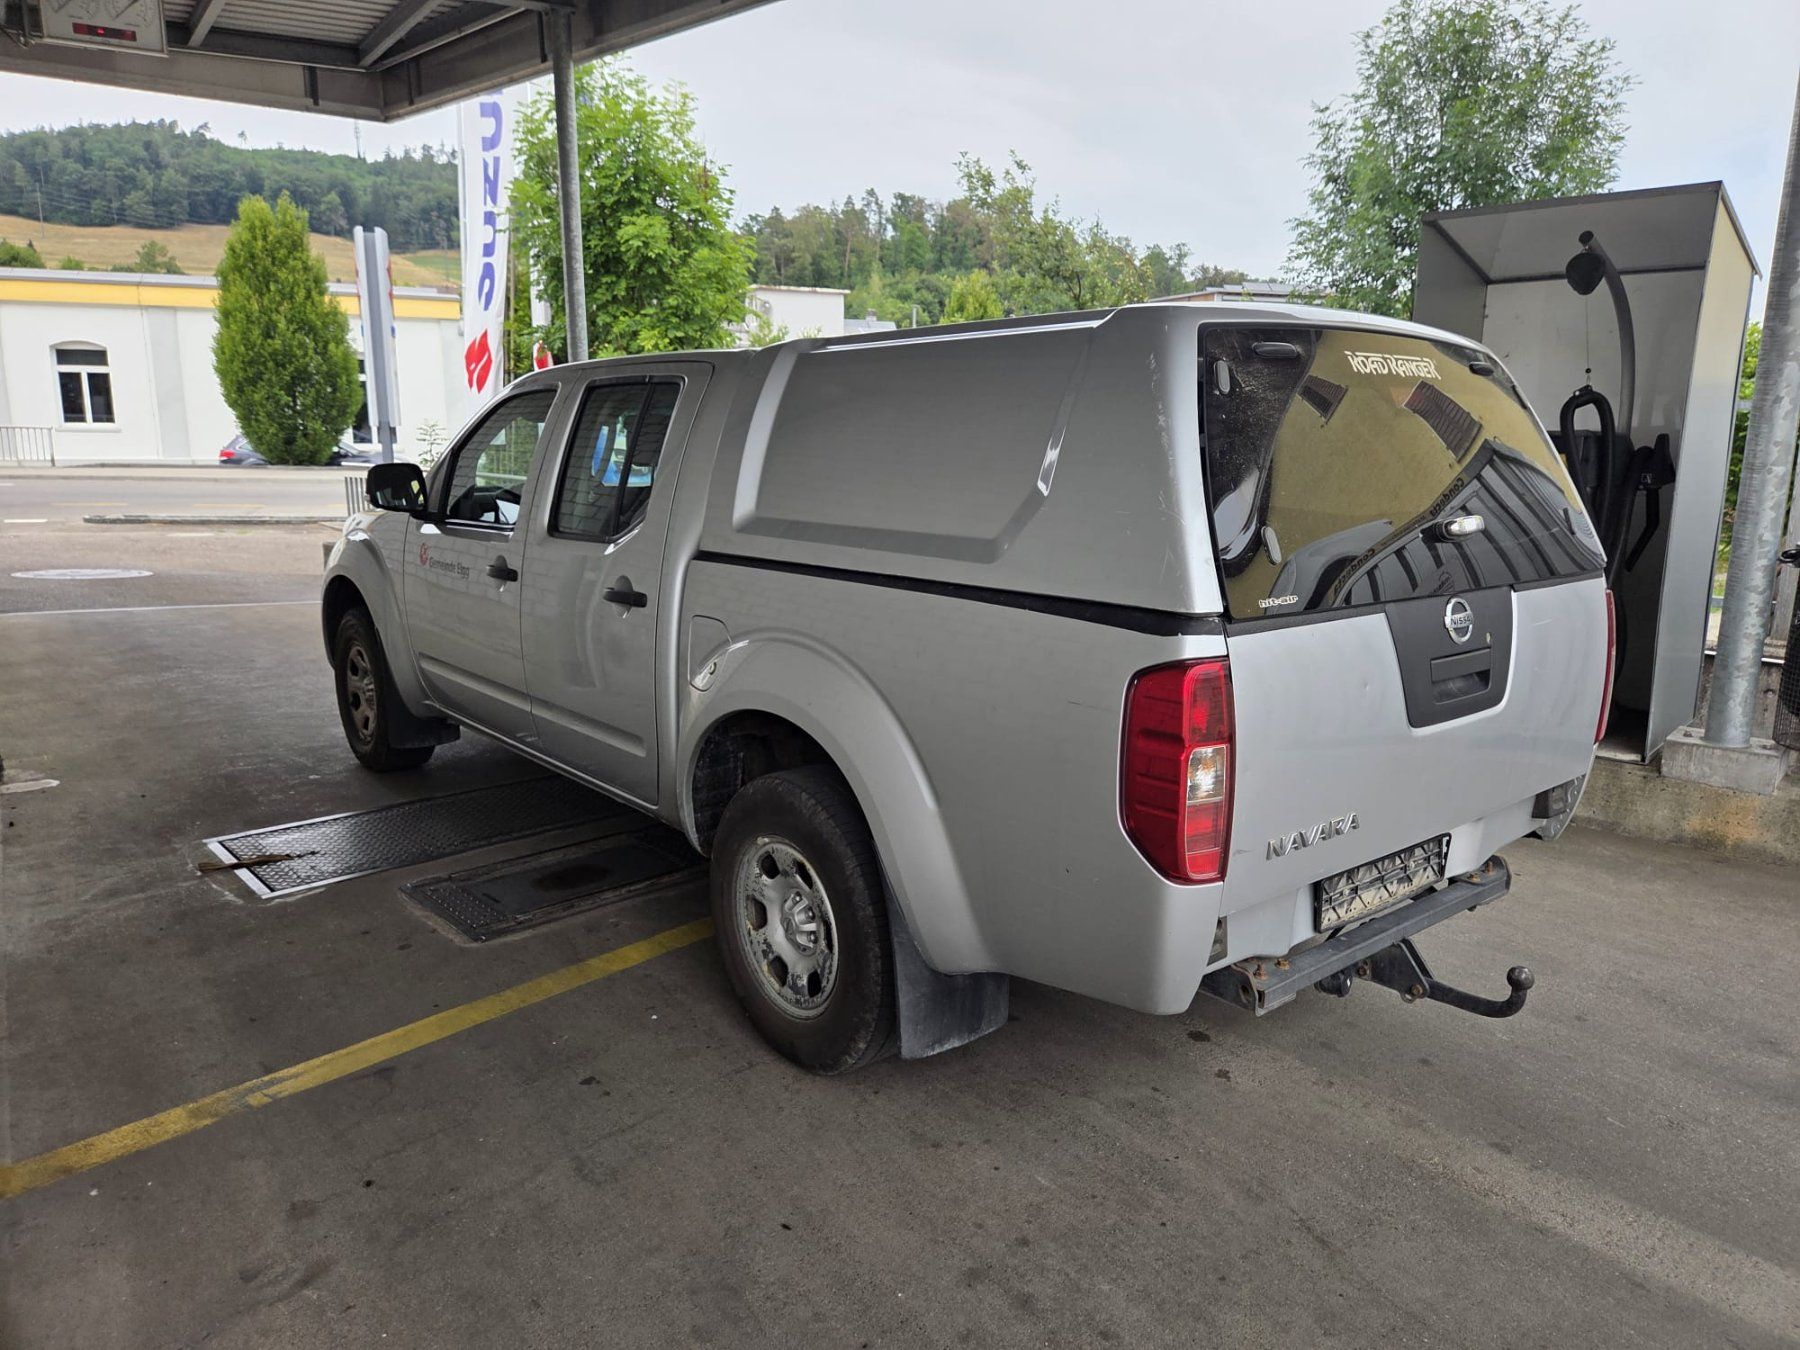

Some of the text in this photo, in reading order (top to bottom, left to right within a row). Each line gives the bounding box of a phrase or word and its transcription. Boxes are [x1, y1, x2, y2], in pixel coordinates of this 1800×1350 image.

[477, 90, 504, 312] SUZU
[1344, 350, 1442, 380] ROAD RANGER
[1266, 812, 1360, 861] NAVARA
